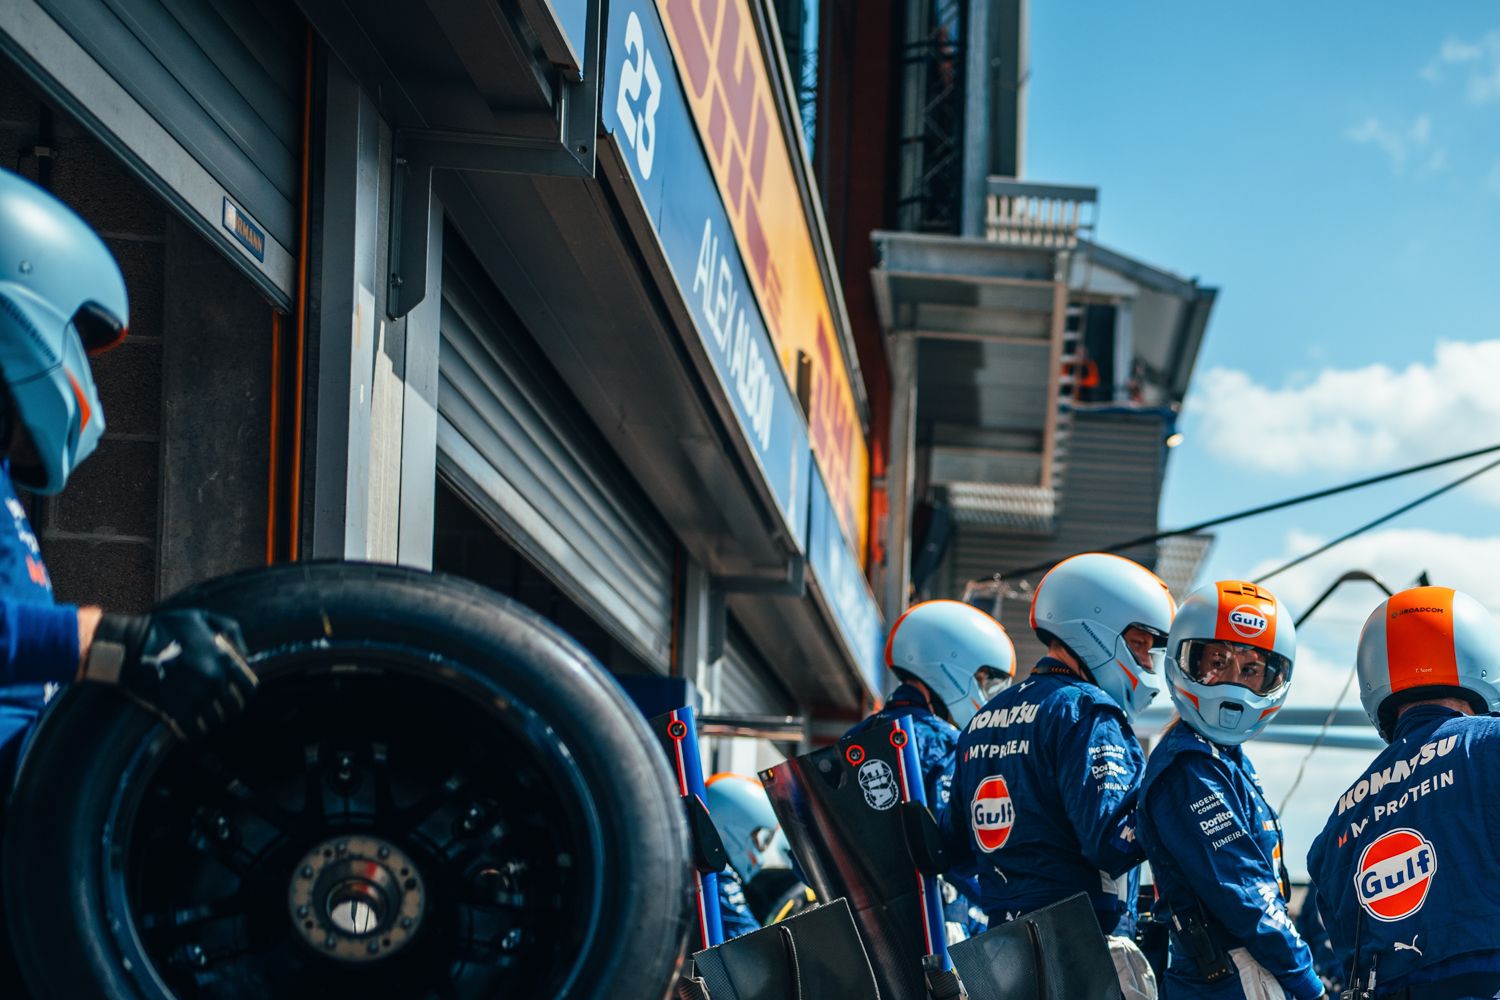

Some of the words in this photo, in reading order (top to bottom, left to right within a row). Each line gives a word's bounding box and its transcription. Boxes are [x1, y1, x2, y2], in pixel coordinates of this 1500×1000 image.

[616, 11, 661, 180] 23
[693, 217, 739, 368] ALEX
[730, 307, 775, 451] ALBON
[1231, 612, 1266, 629] Gulf
[1338, 735, 1458, 816] KOMATSU
[974, 802, 1013, 825] Gulf
[1361, 849, 1430, 899] Gulf
